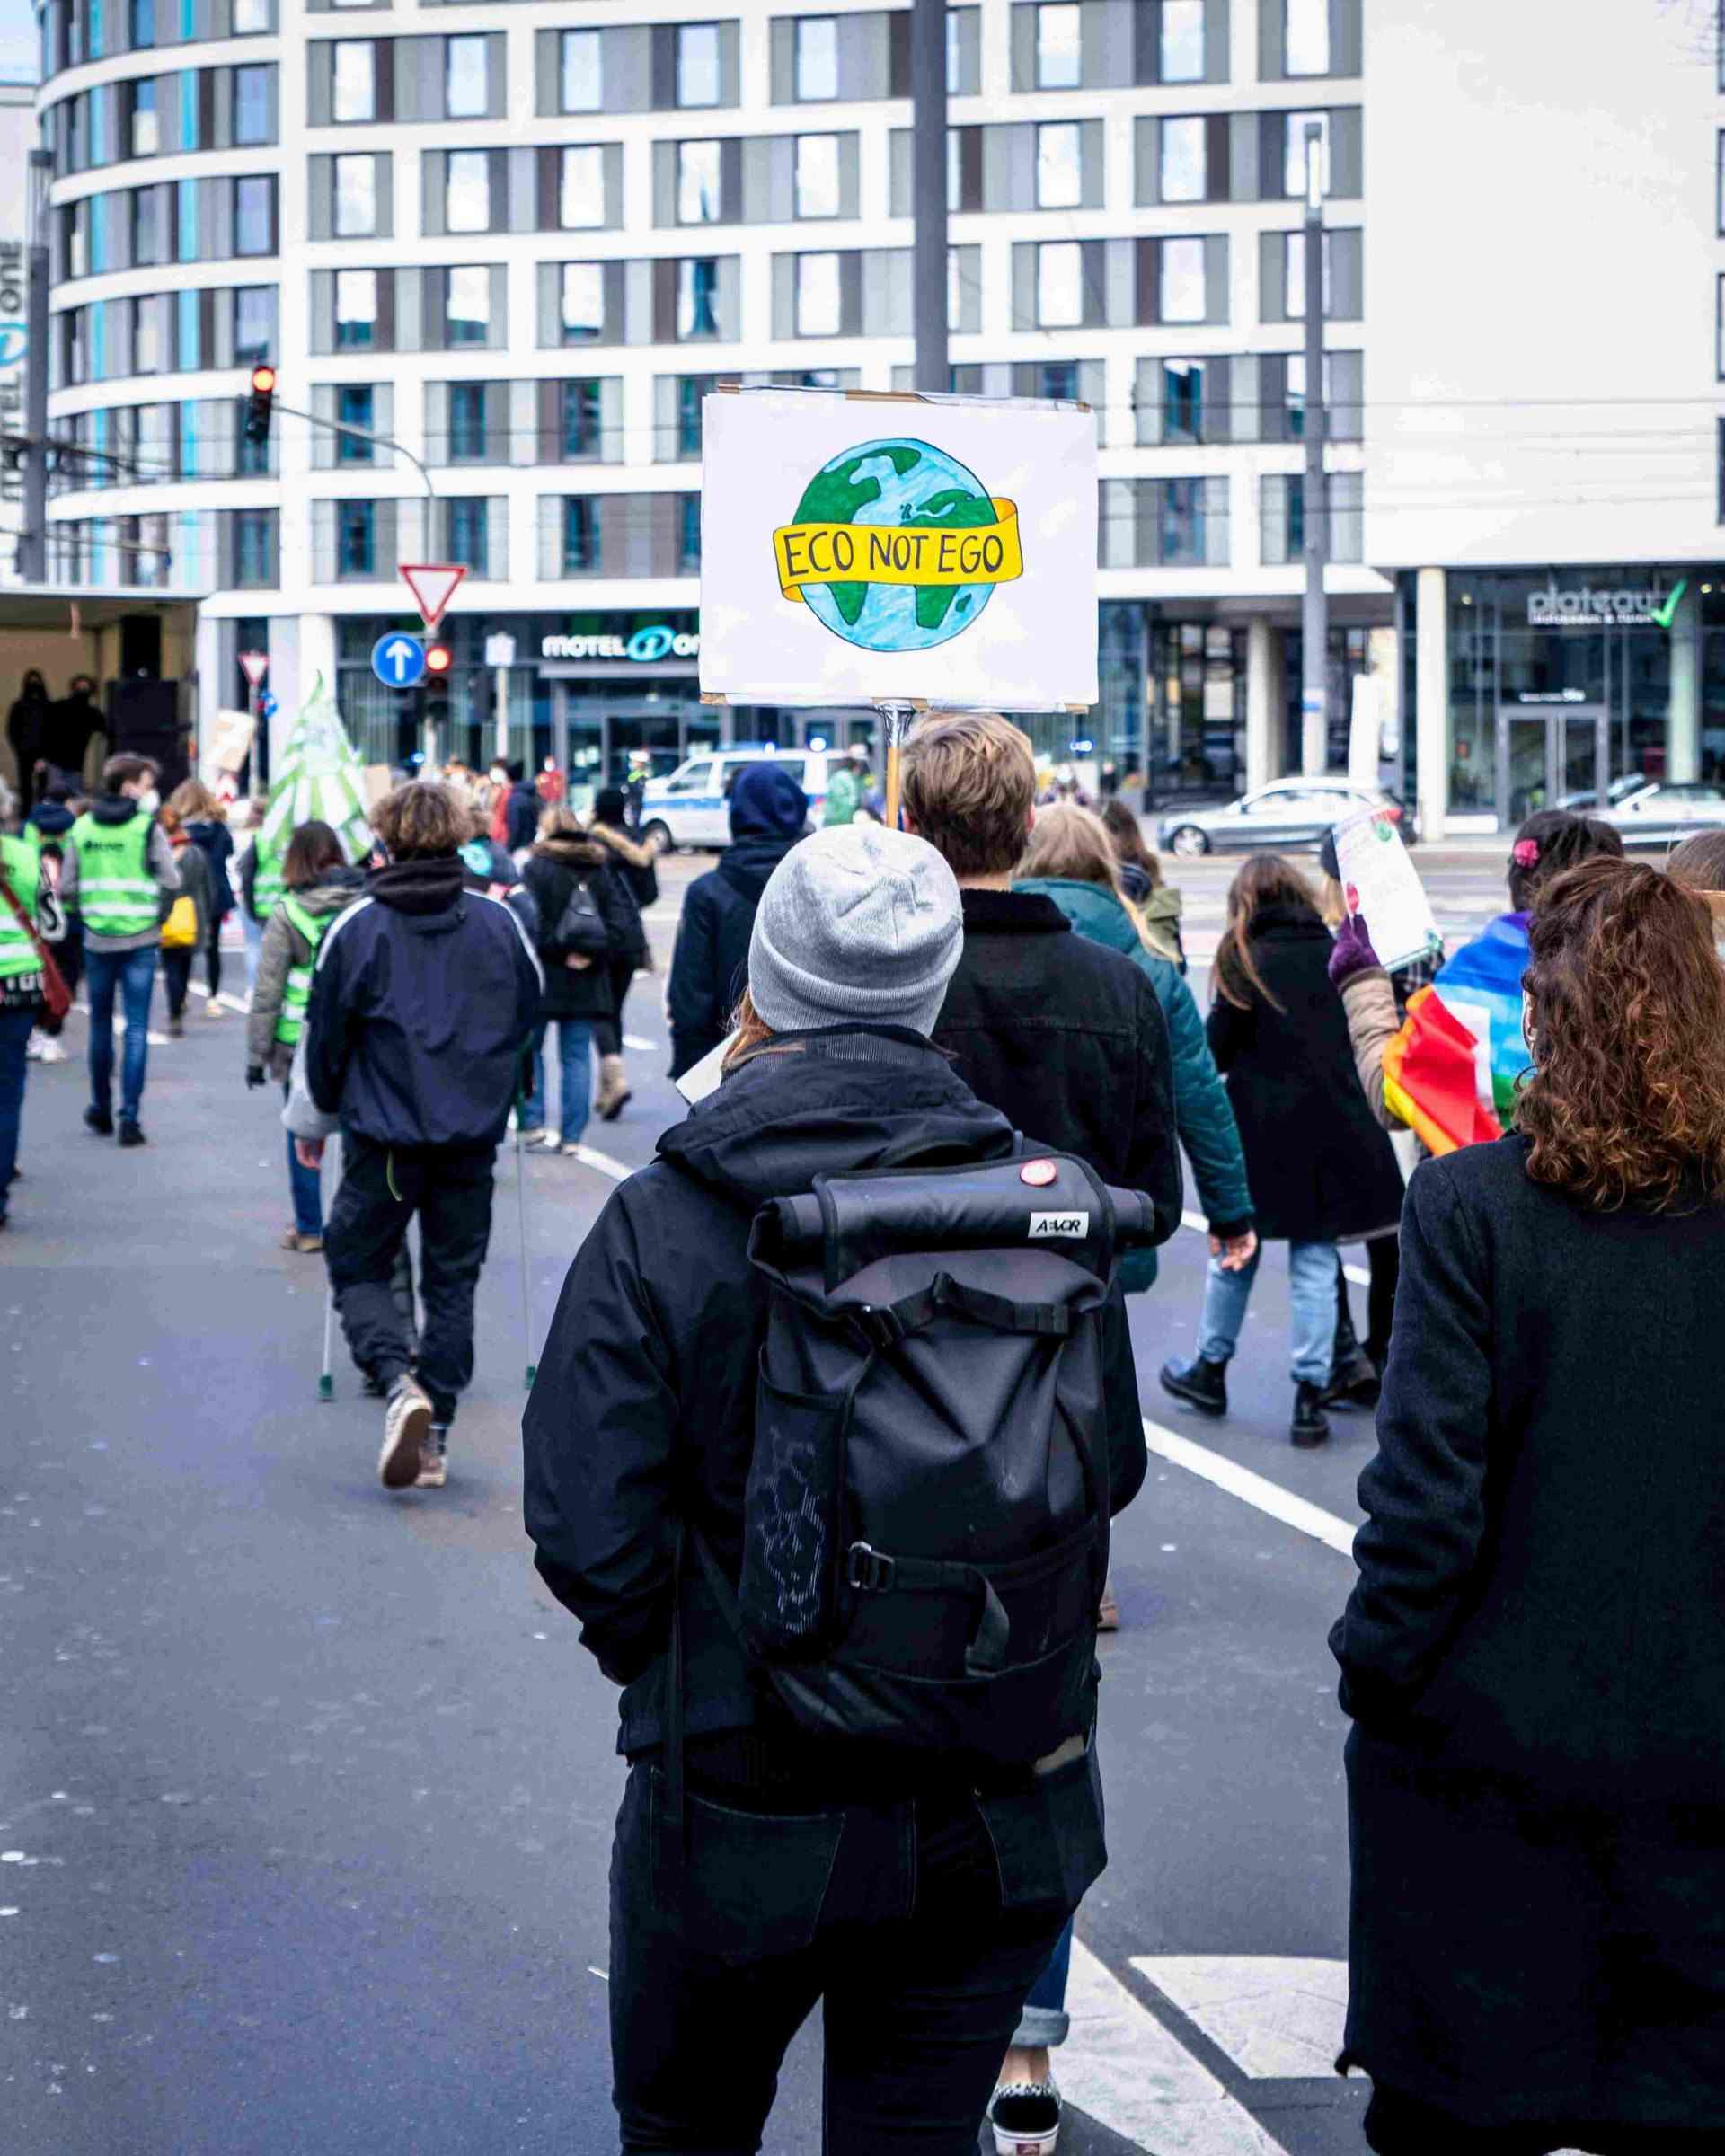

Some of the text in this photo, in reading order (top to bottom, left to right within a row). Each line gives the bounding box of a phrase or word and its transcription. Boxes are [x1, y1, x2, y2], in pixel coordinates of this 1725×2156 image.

[783, 530, 1004, 577] ECO NOT EGO
